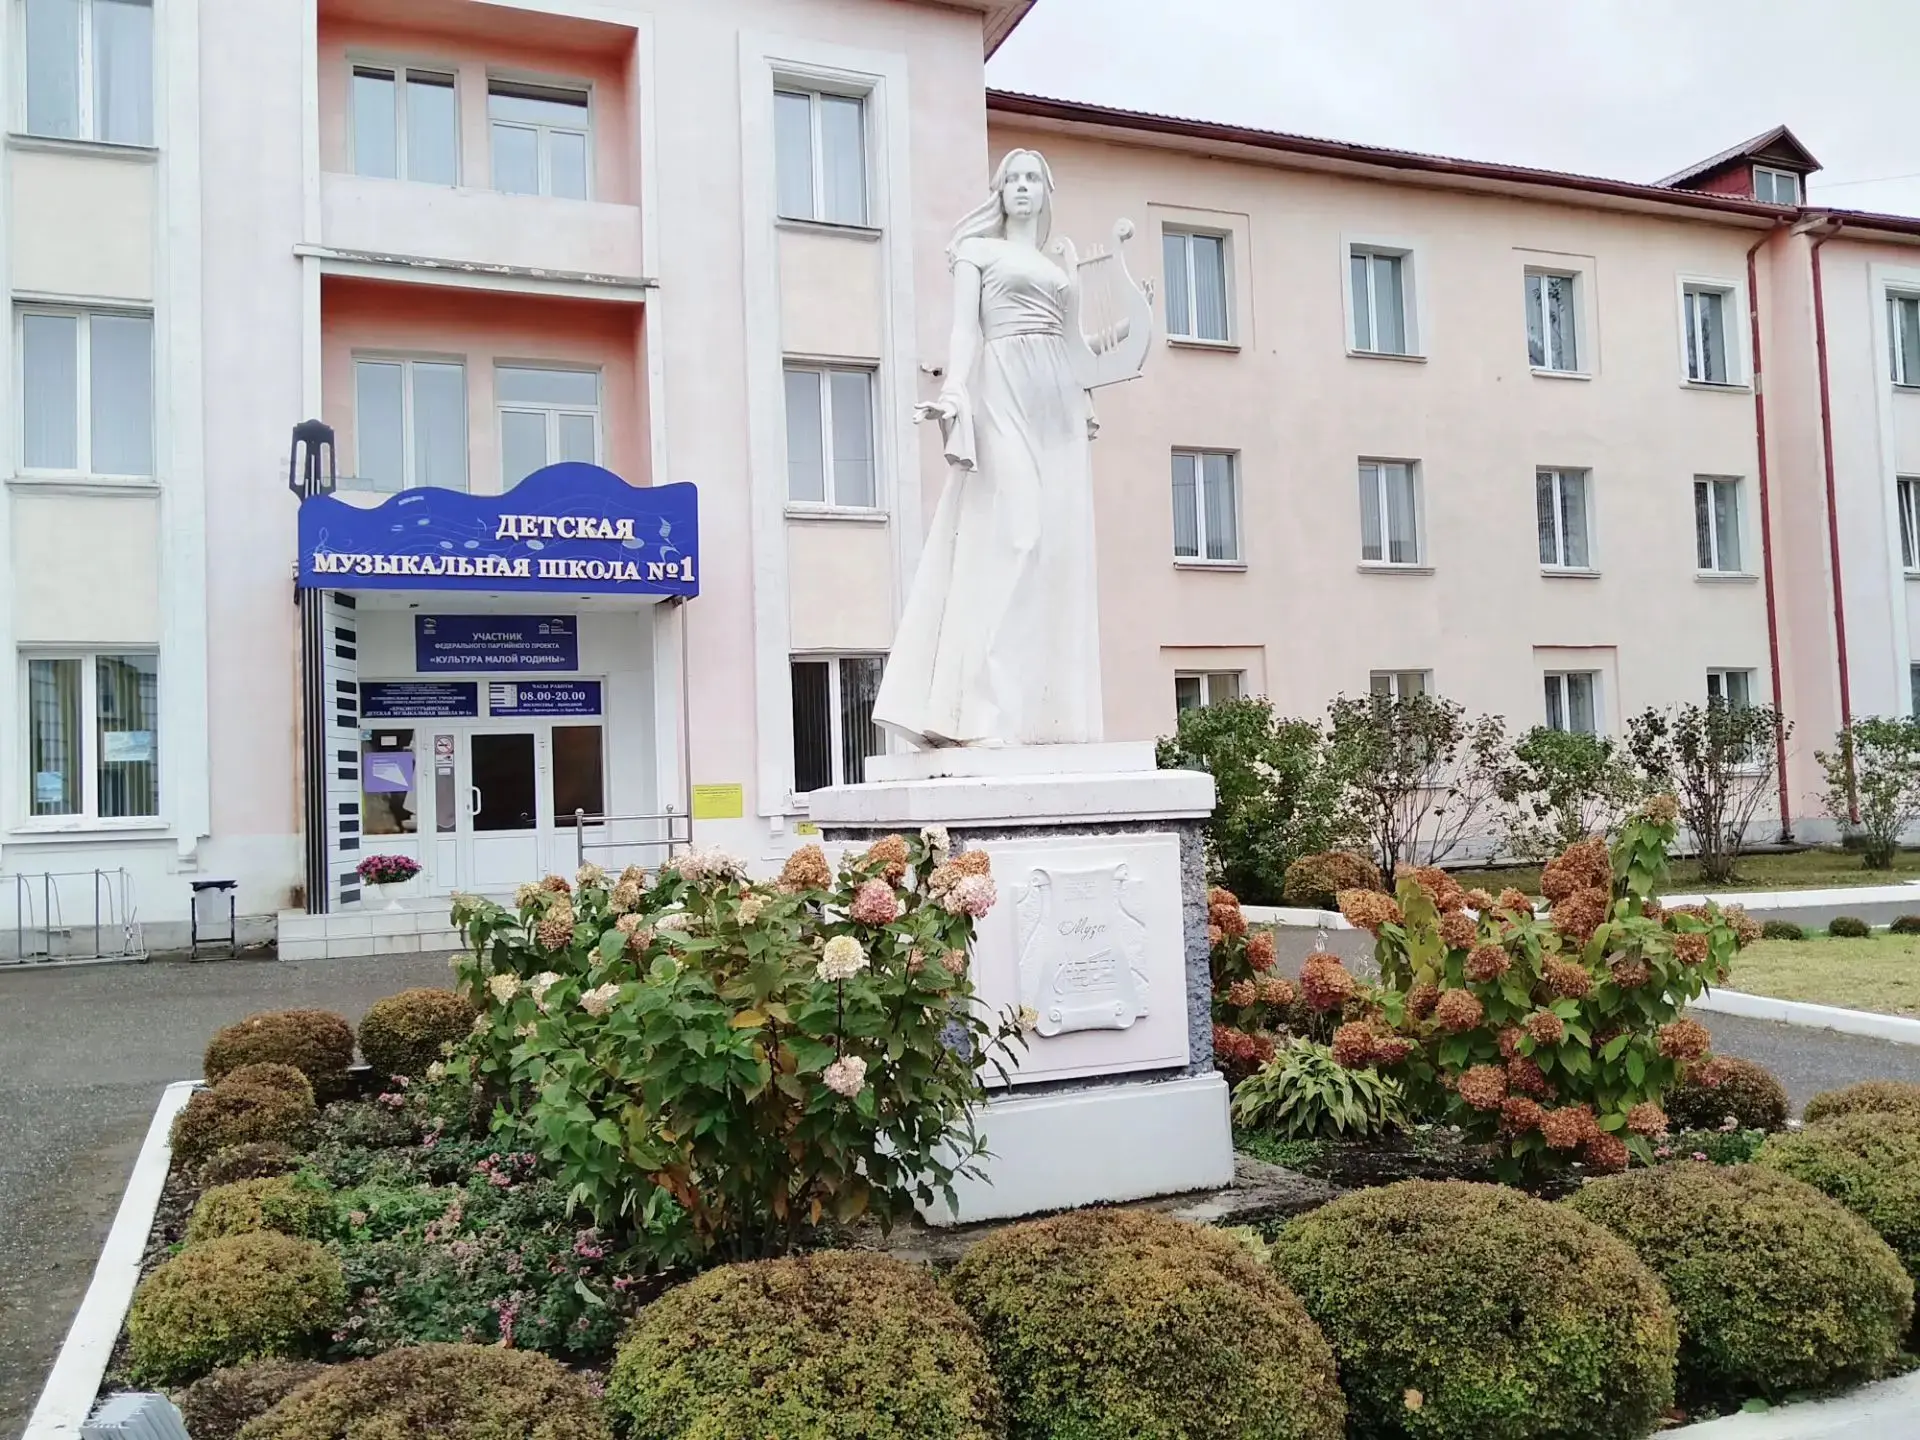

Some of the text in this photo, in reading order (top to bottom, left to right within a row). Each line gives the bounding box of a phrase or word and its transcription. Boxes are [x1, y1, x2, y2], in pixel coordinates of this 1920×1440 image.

[495, 513, 635, 541] ДЕТСКАЯ
[312, 553, 696, 582] МУЗЫКАЛЬНАЯ ШКОЛА №1
[472, 632, 523, 641] УЧАСТНИК
[487, 641, 531, 649] ПАРТИЙНОГО
[429, 653, 566, 665] «КУЛЬТУРА МАЛОЙ РОДИНЫ»
[519, 691, 586, 701] 08.00-20.00
